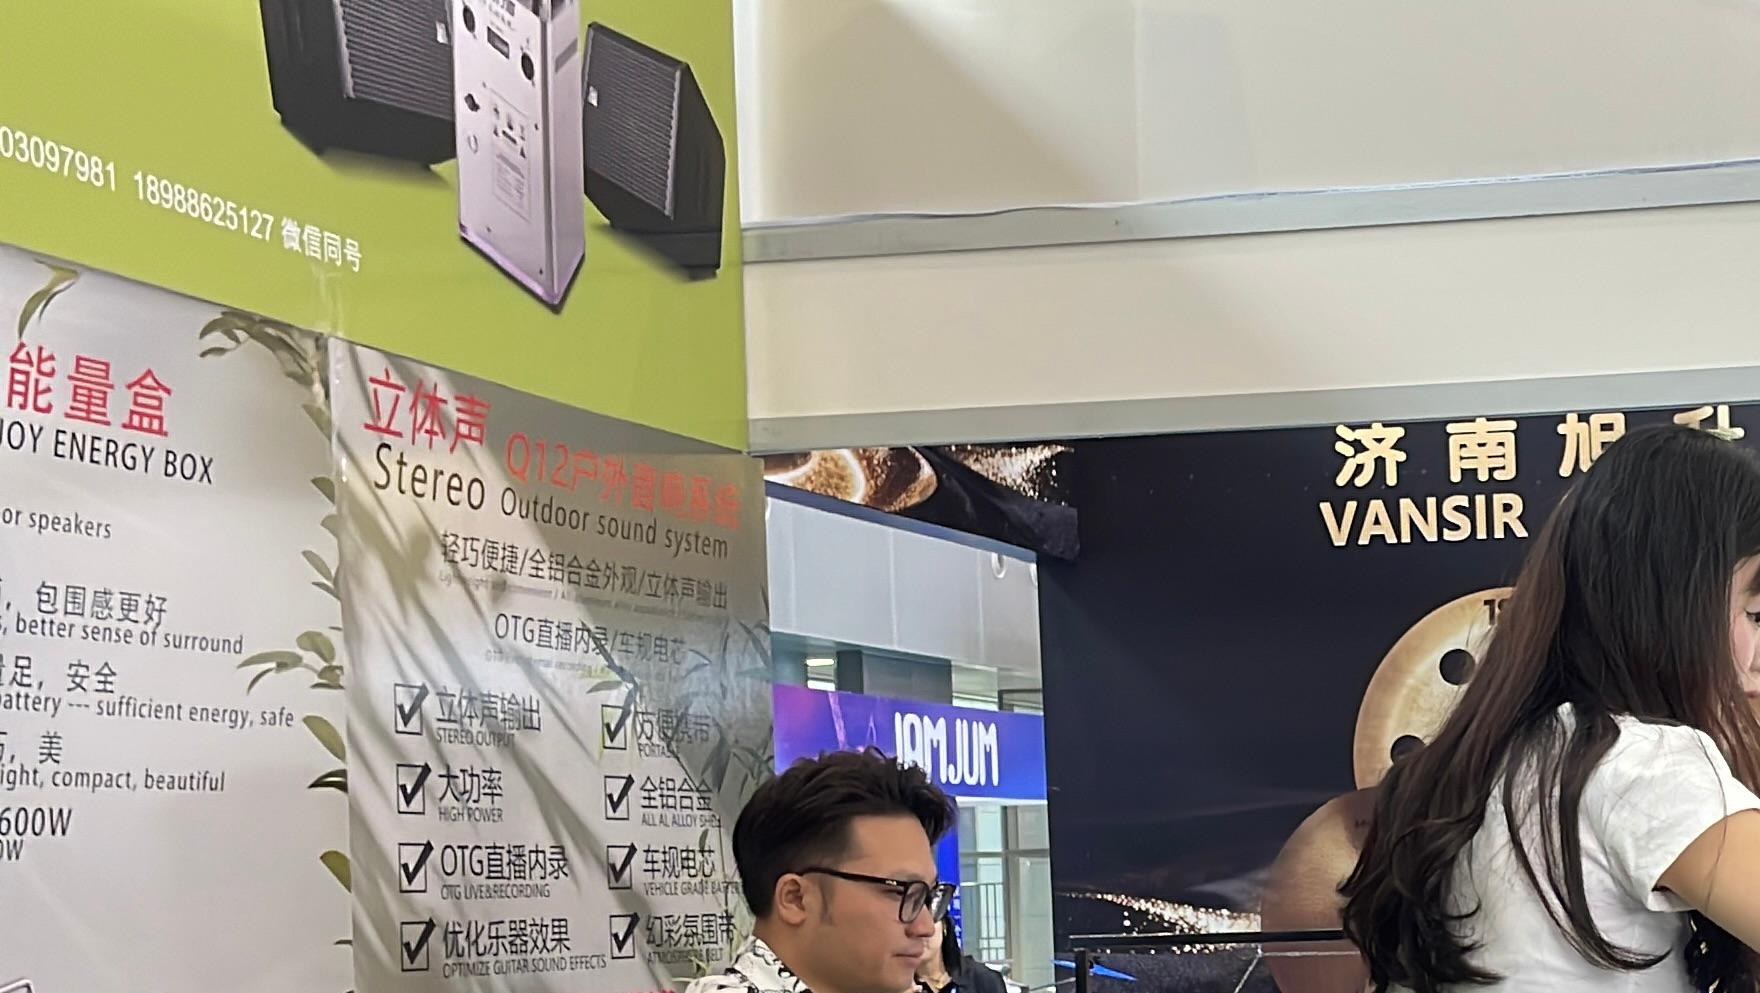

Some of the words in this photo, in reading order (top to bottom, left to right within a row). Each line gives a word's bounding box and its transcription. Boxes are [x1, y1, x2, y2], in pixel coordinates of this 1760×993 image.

[0, 126, 116, 191] 03097981
[134, 170, 275, 242] 18988625127
[281, 216, 362, 272] 微信同号
[6, 342, 173, 437] 能量盒
[363, 368, 491, 454] 立体声
[54, 429, 155, 474] ENERGY
[164, 450, 214, 485] BOX
[374, 442, 486, 510] Stereo
[501, 487, 590, 533] Outdoor
[598, 513, 657, 545] sound
[665, 527, 728, 561] system
[1319, 494, 1529, 547] VANSIR
[29, 511, 112, 538] speakers
[0, 579, 168, 625] ，包围感更好
[16, 613, 74, 639] better
[81, 627, 133, 645] sense
[139, 626, 161, 648] of
[163, 635, 243, 655] surround
[0, 690, 61, 718] attery
[96, 696, 182, 722] sufficient
[189, 704, 254, 730] energy,
[260, 706, 294, 728] safe
[436, 686, 541, 733] 立体声输出
[436, 727, 474, 747] STEREO
[52, 768, 137, 794] compact,
[144, 768, 225, 793] beautiful
[438, 766, 503, 806] 大功率
[640, 776, 713, 811] 全铝合金
[0, 806, 73, 837] 600W
[438, 805, 466, 823] HIGH
[467, 806, 504, 823] POWER
[441, 843, 569, 881] OTG直播内录
[643, 845, 714, 880] 车规电芯
[441, 884, 461, 900] OTG
[443, 917, 571, 959] 优化乐器效果
[442, 959, 490, 978] OPTIMIZE
[493, 957, 529, 976] GUITAR
[569, 954, 607, 971] EFFECTS
